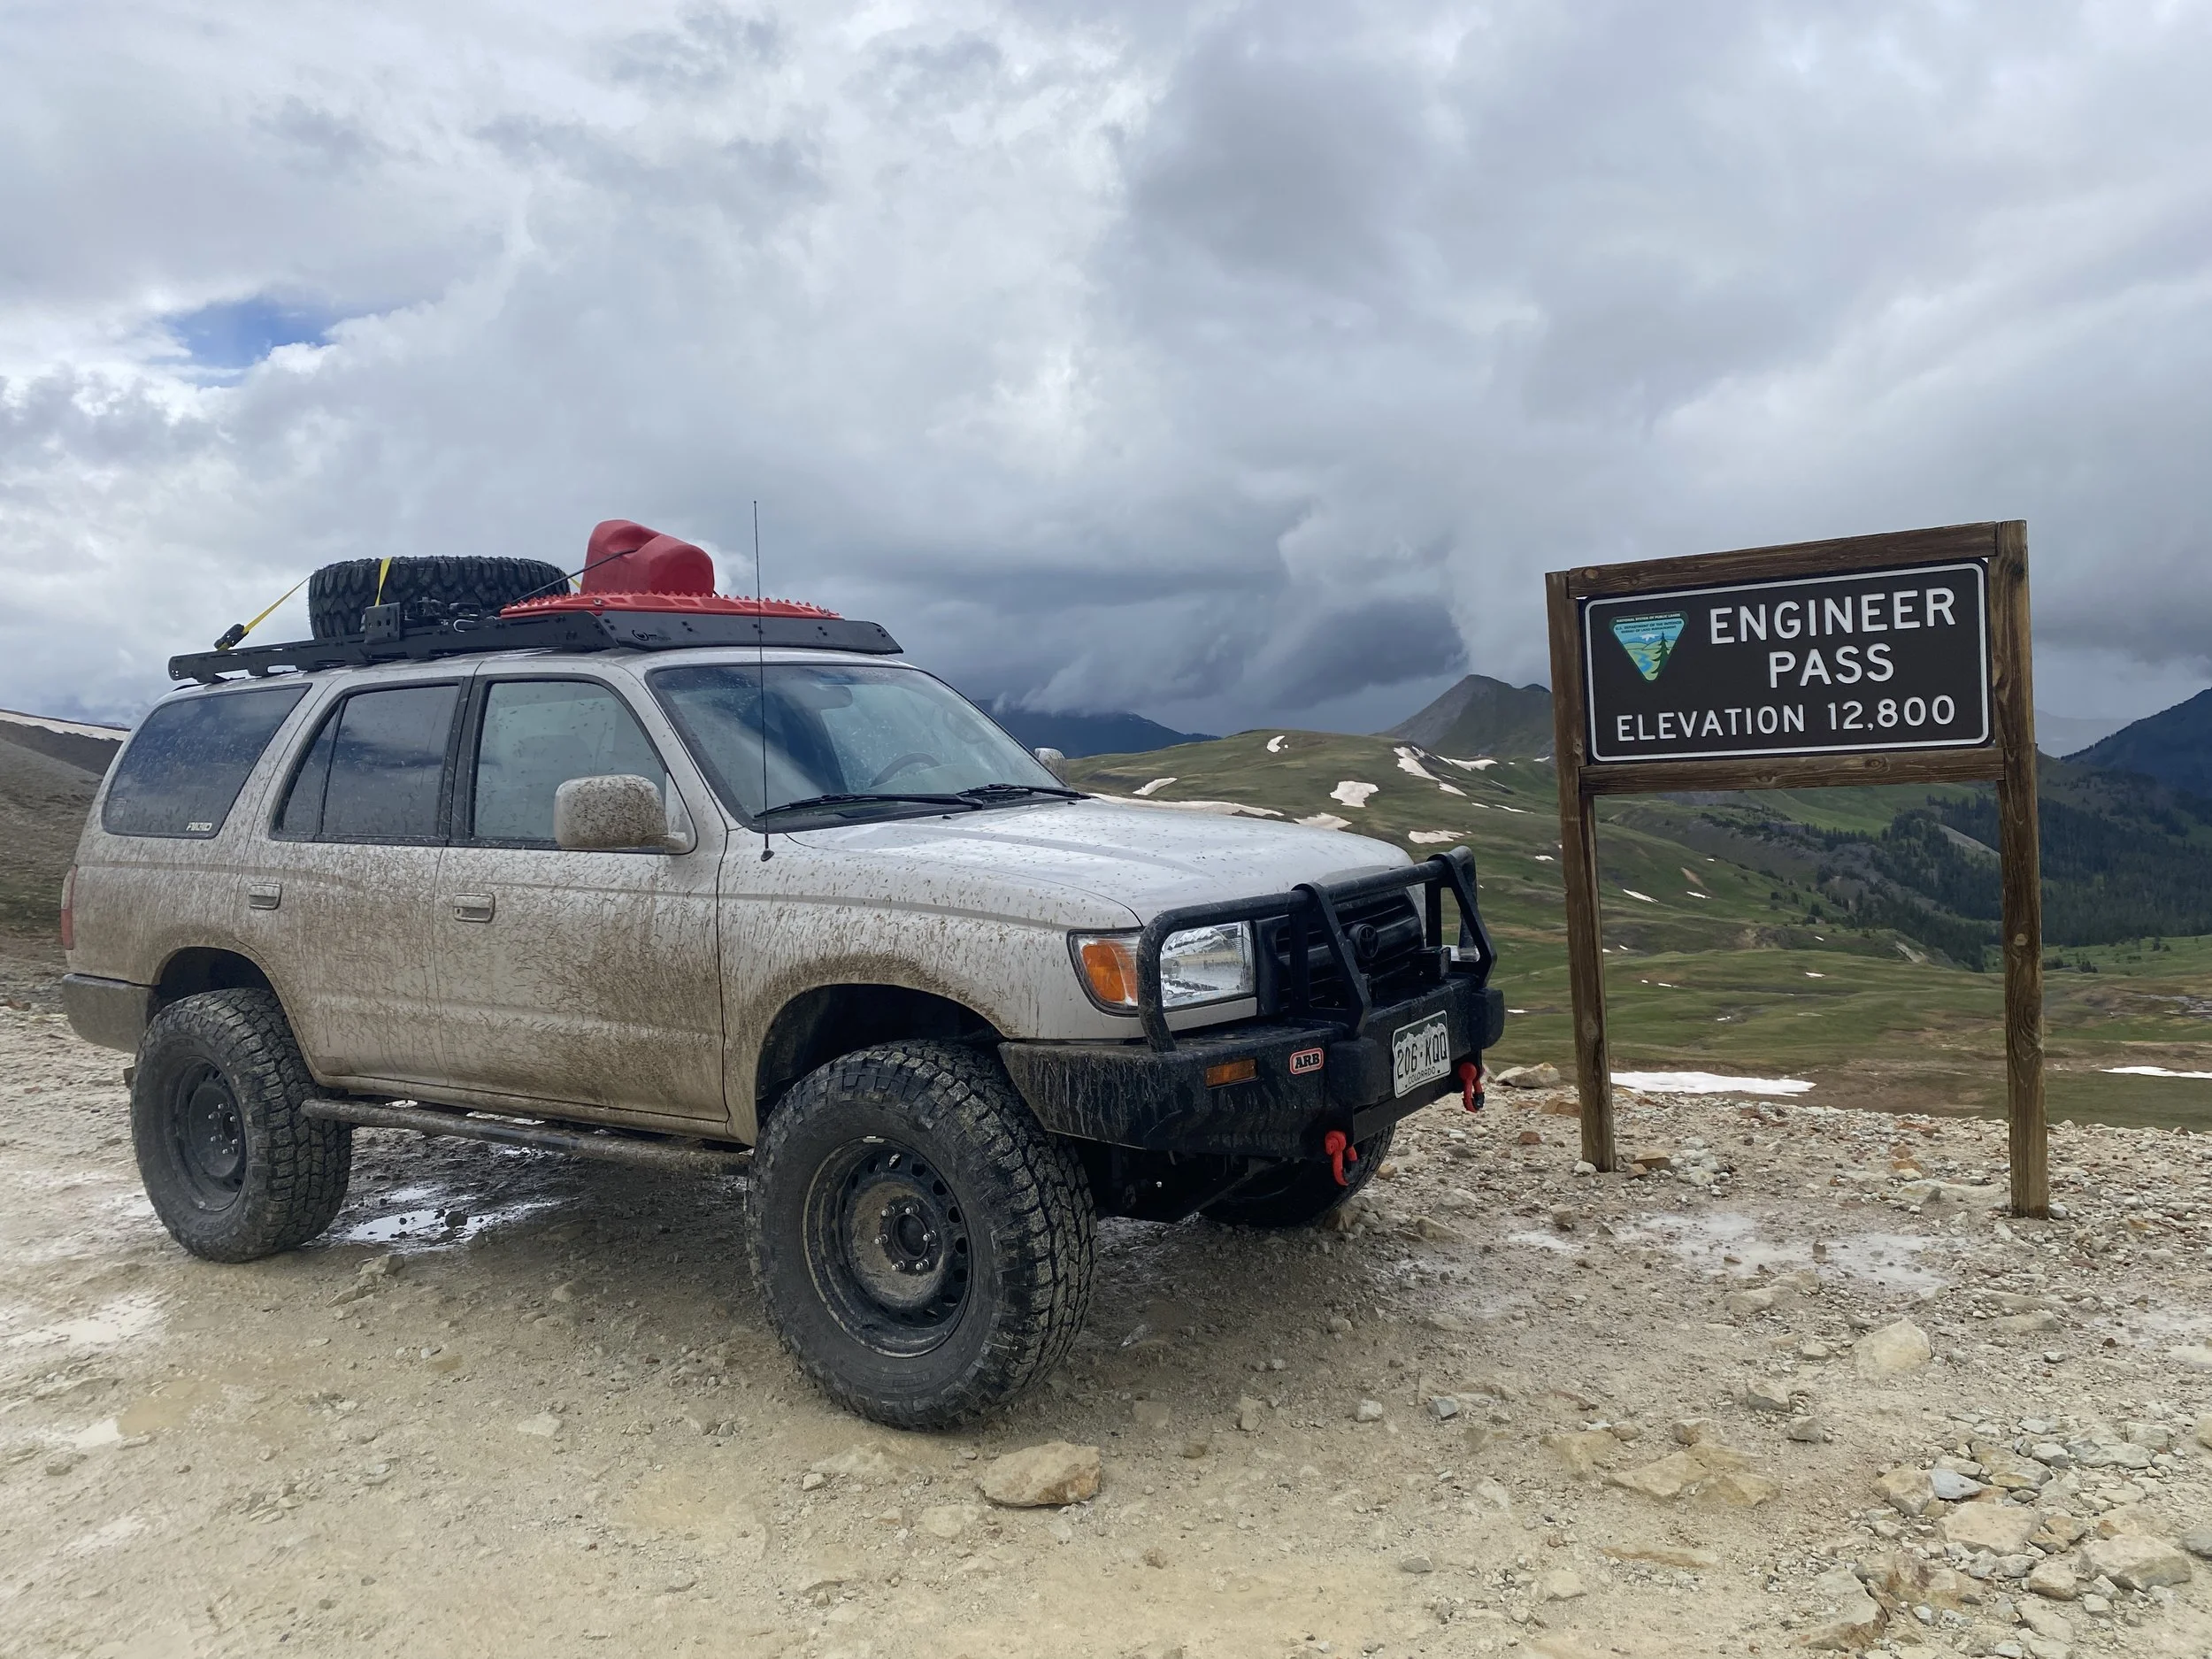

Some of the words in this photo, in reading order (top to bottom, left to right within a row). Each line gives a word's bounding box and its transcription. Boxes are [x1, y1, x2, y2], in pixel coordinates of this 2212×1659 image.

[1709, 588, 1955, 645] ENGINEER
[1770, 642, 1893, 687] PASS
[1617, 704, 1804, 741] ELEVATION
[1828, 695, 1955, 730] 12,800
[1294, 1053, 1320, 1069] ARB
[1408, 1066, 1436, 1084] COLORADO
